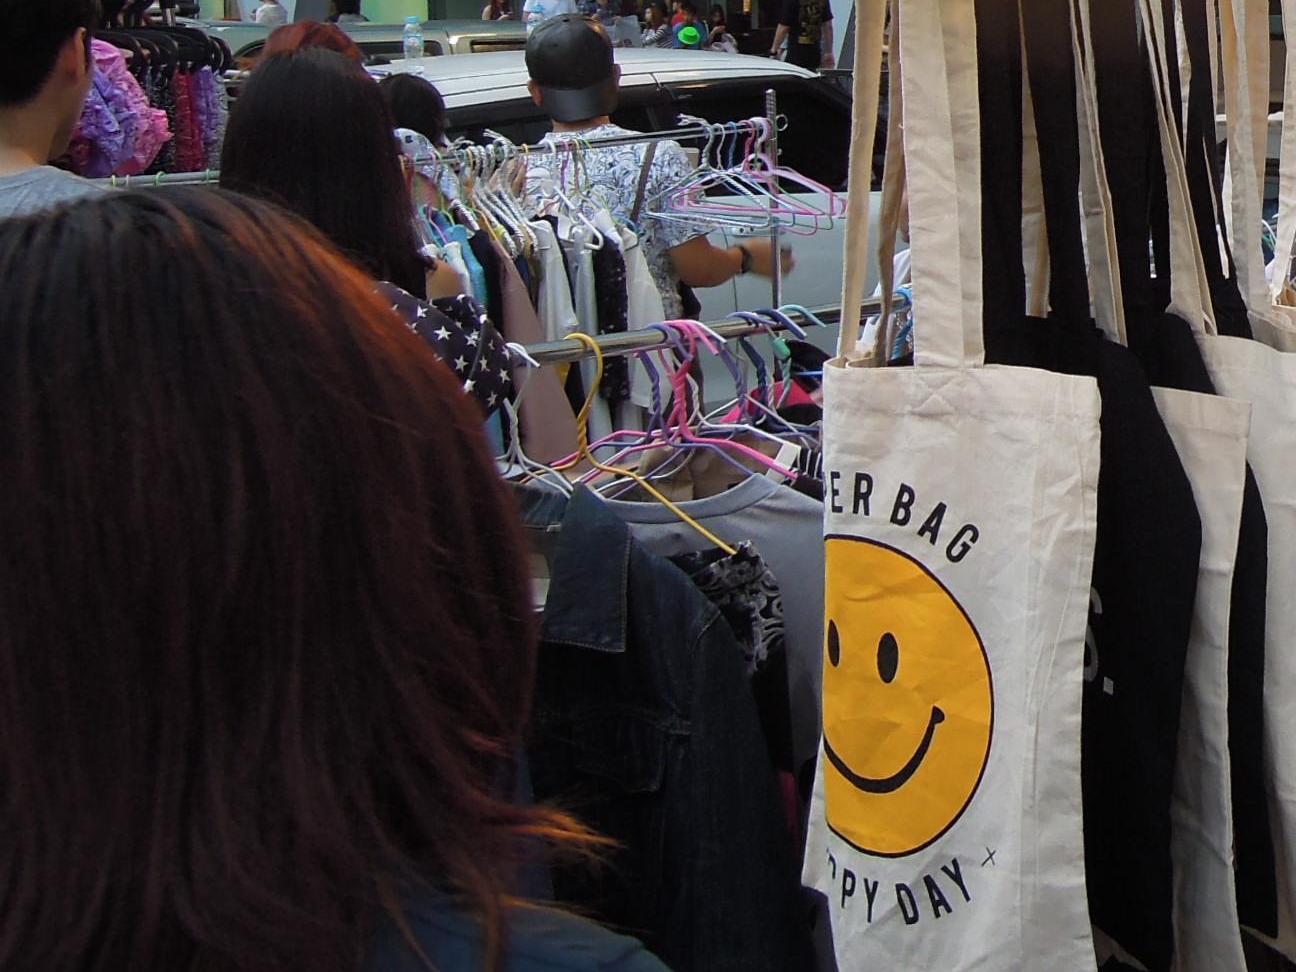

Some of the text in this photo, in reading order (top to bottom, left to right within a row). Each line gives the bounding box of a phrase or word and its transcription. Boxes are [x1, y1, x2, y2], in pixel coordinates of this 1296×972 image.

[824, 471, 979, 563] ER BAG
[895, 858, 971, 925] DAY
